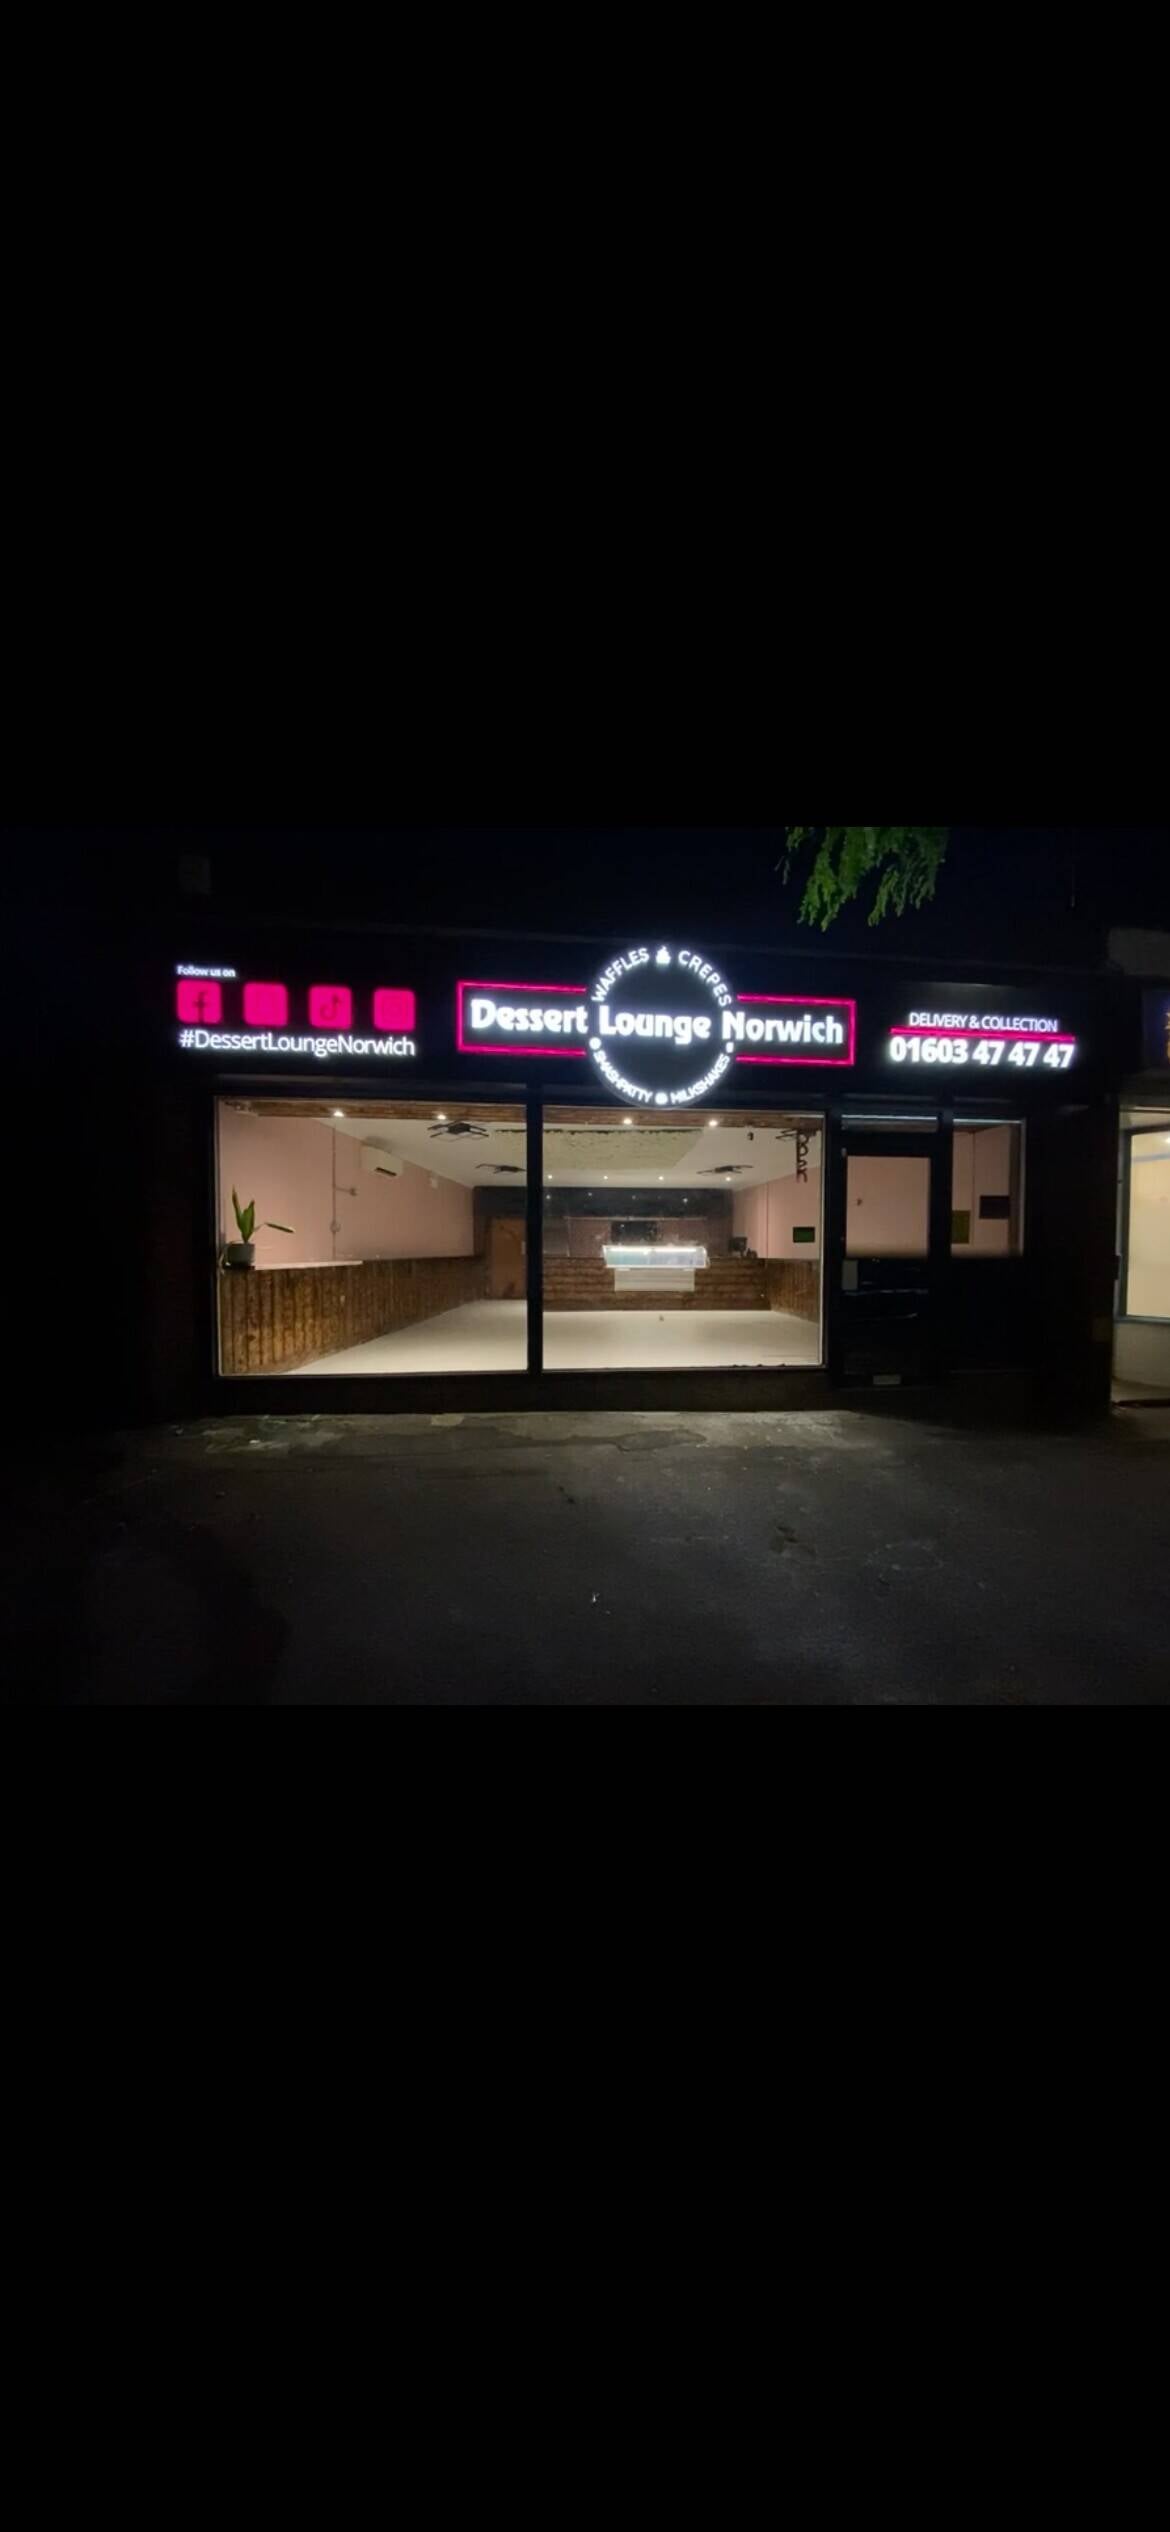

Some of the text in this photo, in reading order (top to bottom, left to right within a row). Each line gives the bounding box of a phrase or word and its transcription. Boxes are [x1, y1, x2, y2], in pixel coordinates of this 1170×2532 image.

[177, 965, 236, 977] Follow us on
[591, 948, 731, 1006] WAFFLES CREPES
[471, 999, 843, 1045] Dessert Lounge Norwich
[909, 1012, 1058, 1032] DELIVERY & COLLECTION
[180, 1030, 414, 1057] #DessertLoungeNorwich
[889, 1036, 1074, 1067] 01603 47 47 47
[670, 1054, 730, 1103] MILKSHAKES
